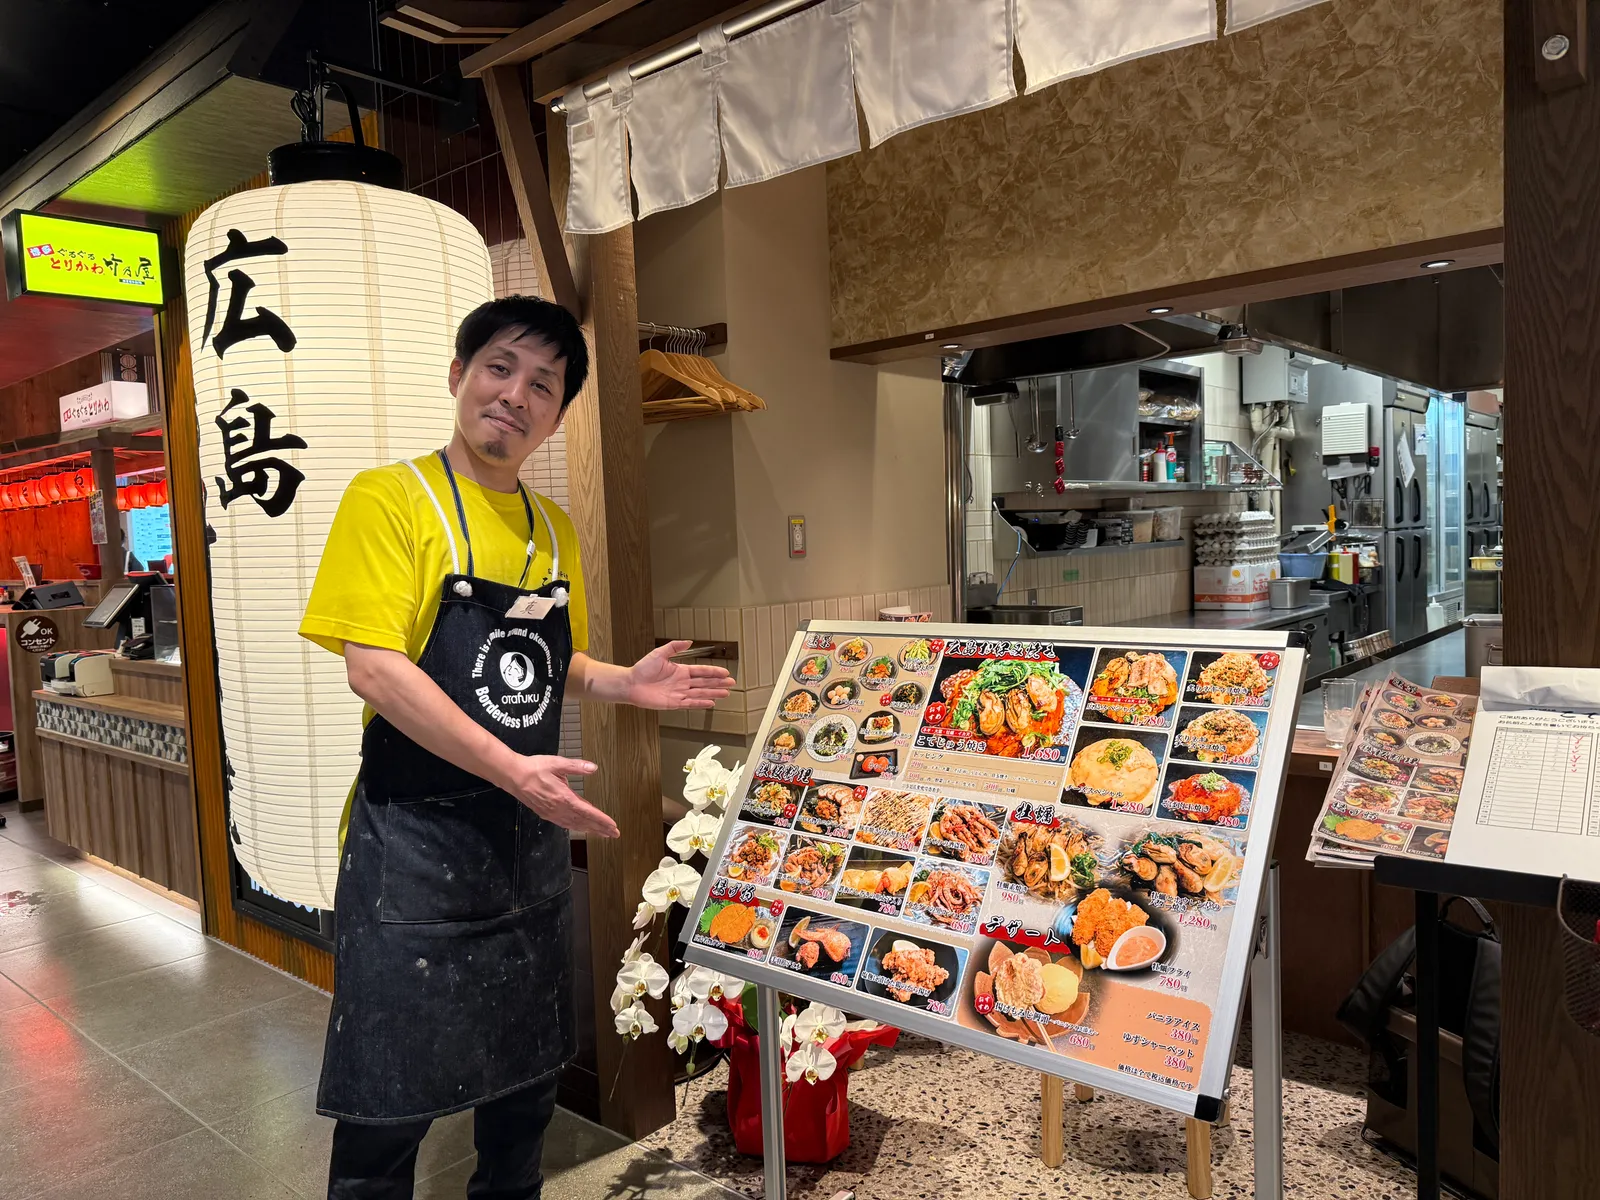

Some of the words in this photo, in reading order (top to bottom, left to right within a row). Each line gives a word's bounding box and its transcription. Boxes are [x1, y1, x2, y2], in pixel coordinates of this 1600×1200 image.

[57, 248, 95, 261] ぐるぐる
[50, 257, 104, 275] とりかわ
[200, 228, 308, 517] 広島
[40, 627, 53, 636] OK
[21, 637, 56, 646] コンセント
[946, 639, 1056, 659] 広島お好み焼き
[472, 653, 486, 678] There
[479, 643, 490, 653] is
[475, 685, 521, 729] Borderless
[522, 685, 552, 728] Happiness
[917, 735, 987, 752] こてじゅう焼き
[913, 751, 943, 759] トッピング
[1022, 747, 1065, 762] 1,680円
[1015, 801, 1055, 824] 牡蠣
[712, 878, 756, 903] 揚げ物
[1001, 891, 1024, 905] 980円
[985, 916, 1061, 946] デザート
[1178, 914, 1217, 931] 1,280円
[1152, 962, 1191, 979] 牡蠣フライ
[1160, 976, 1188, 992] 780円
[1146, 1011, 1200, 1032] バニラアイス
[1069, 1034, 1095, 1050] 680円
[1170, 1028, 1199, 1045] 380円
[1123, 1032, 1194, 1059] ゆずシャーベット
[1164, 1055, 1193, 1073] 380円
